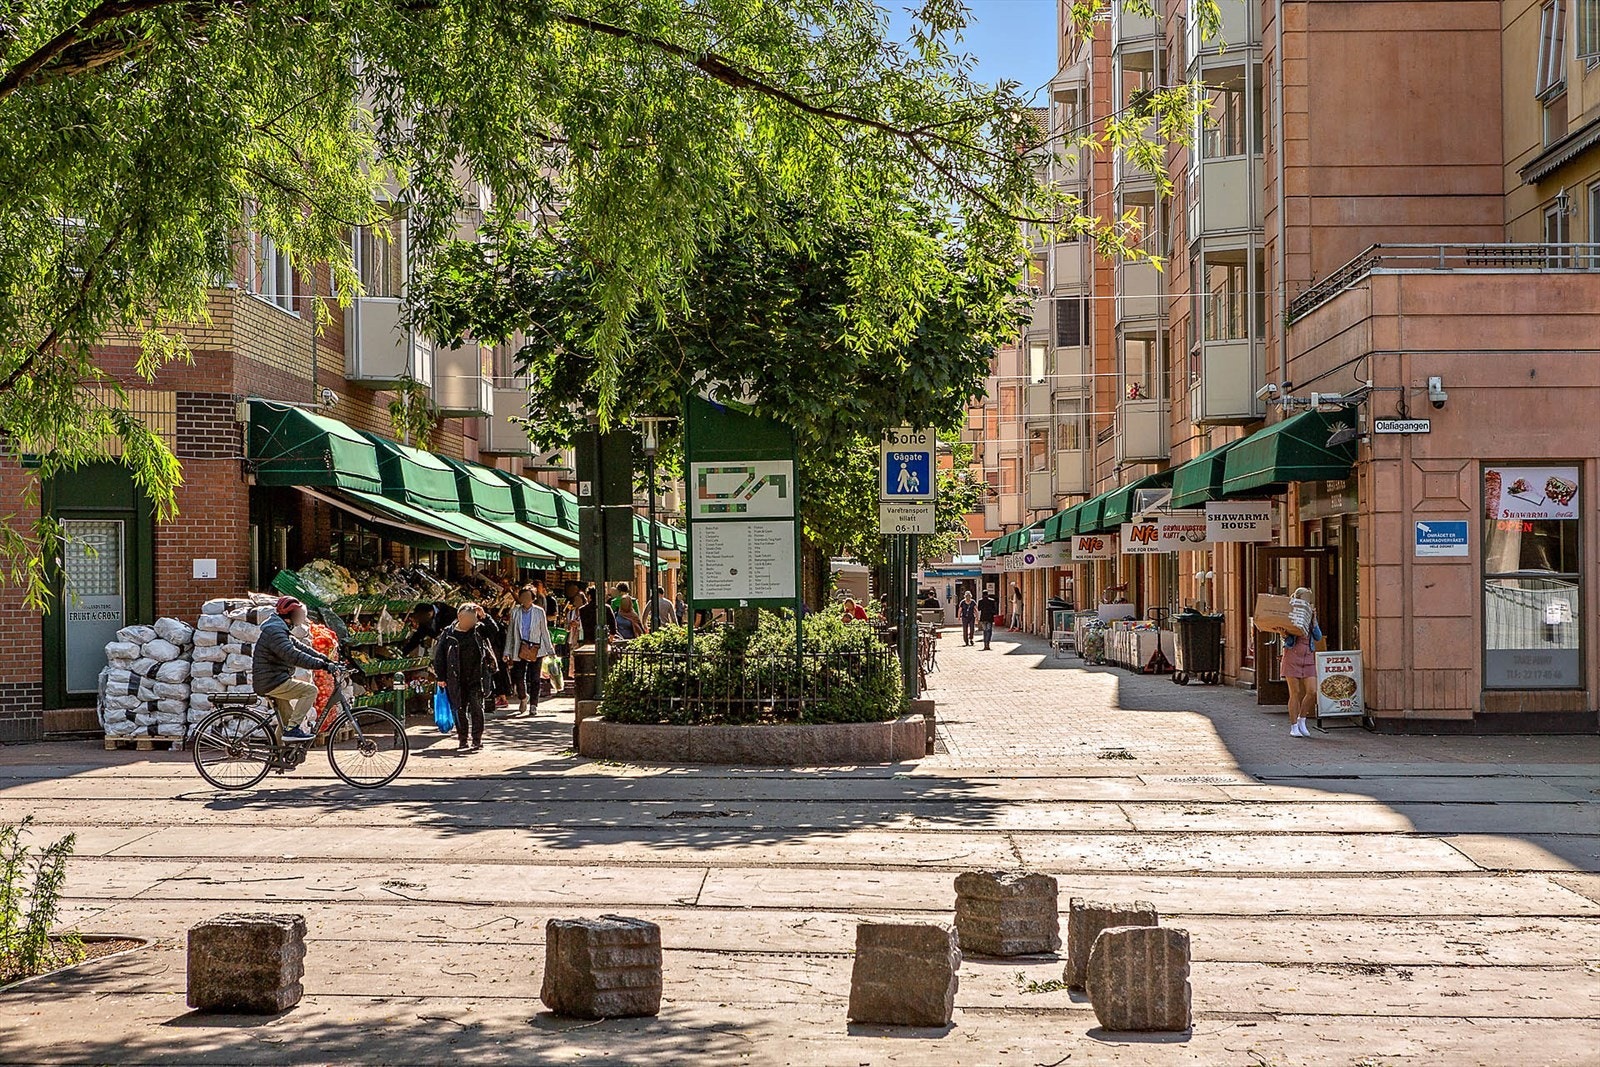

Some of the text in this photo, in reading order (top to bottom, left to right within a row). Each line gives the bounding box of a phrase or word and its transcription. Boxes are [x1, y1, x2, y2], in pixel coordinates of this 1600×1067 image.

[1376, 421, 1429, 432] Olafiagangen
[892, 431, 927, 445] Sone
[893, 452, 923, 463] Gågate
[887, 507, 929, 515] Varetransport
[1208, 513, 1270, 522] SHAWARMA
[1221, 522, 1256, 530] HOUSE
[1497, 520, 1534, 533] OPEN
[1130, 524, 1158, 545] Nfe
[1078, 536, 1104, 553] Nfe
[69, 611, 120, 621] FRUKT & GRØNT
[1325, 665, 1354, 673] KEBAB
